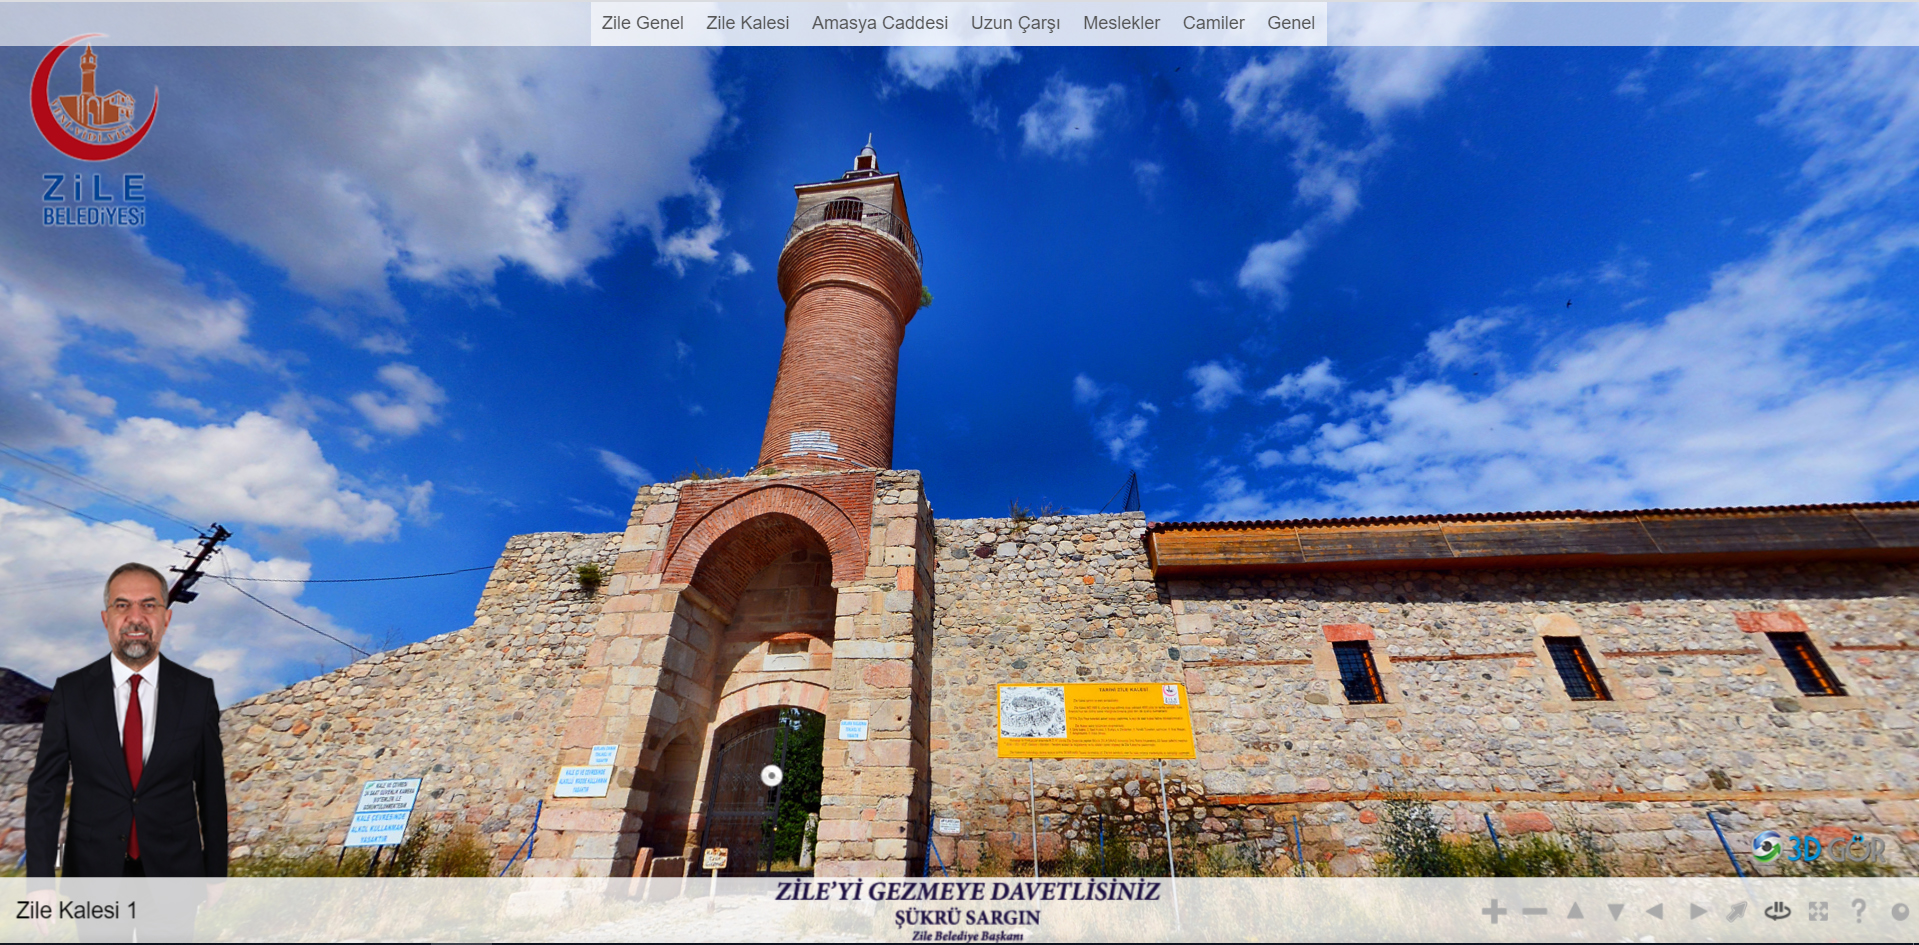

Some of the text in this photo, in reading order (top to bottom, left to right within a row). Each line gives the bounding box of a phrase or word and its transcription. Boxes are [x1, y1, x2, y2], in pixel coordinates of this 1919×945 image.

[356, 813, 406, 822] KALE ÇEVRESİNDE
[351, 824, 404, 833] ALKOL KULLANMAK
[360, 835, 388, 843] YASAKTIR
